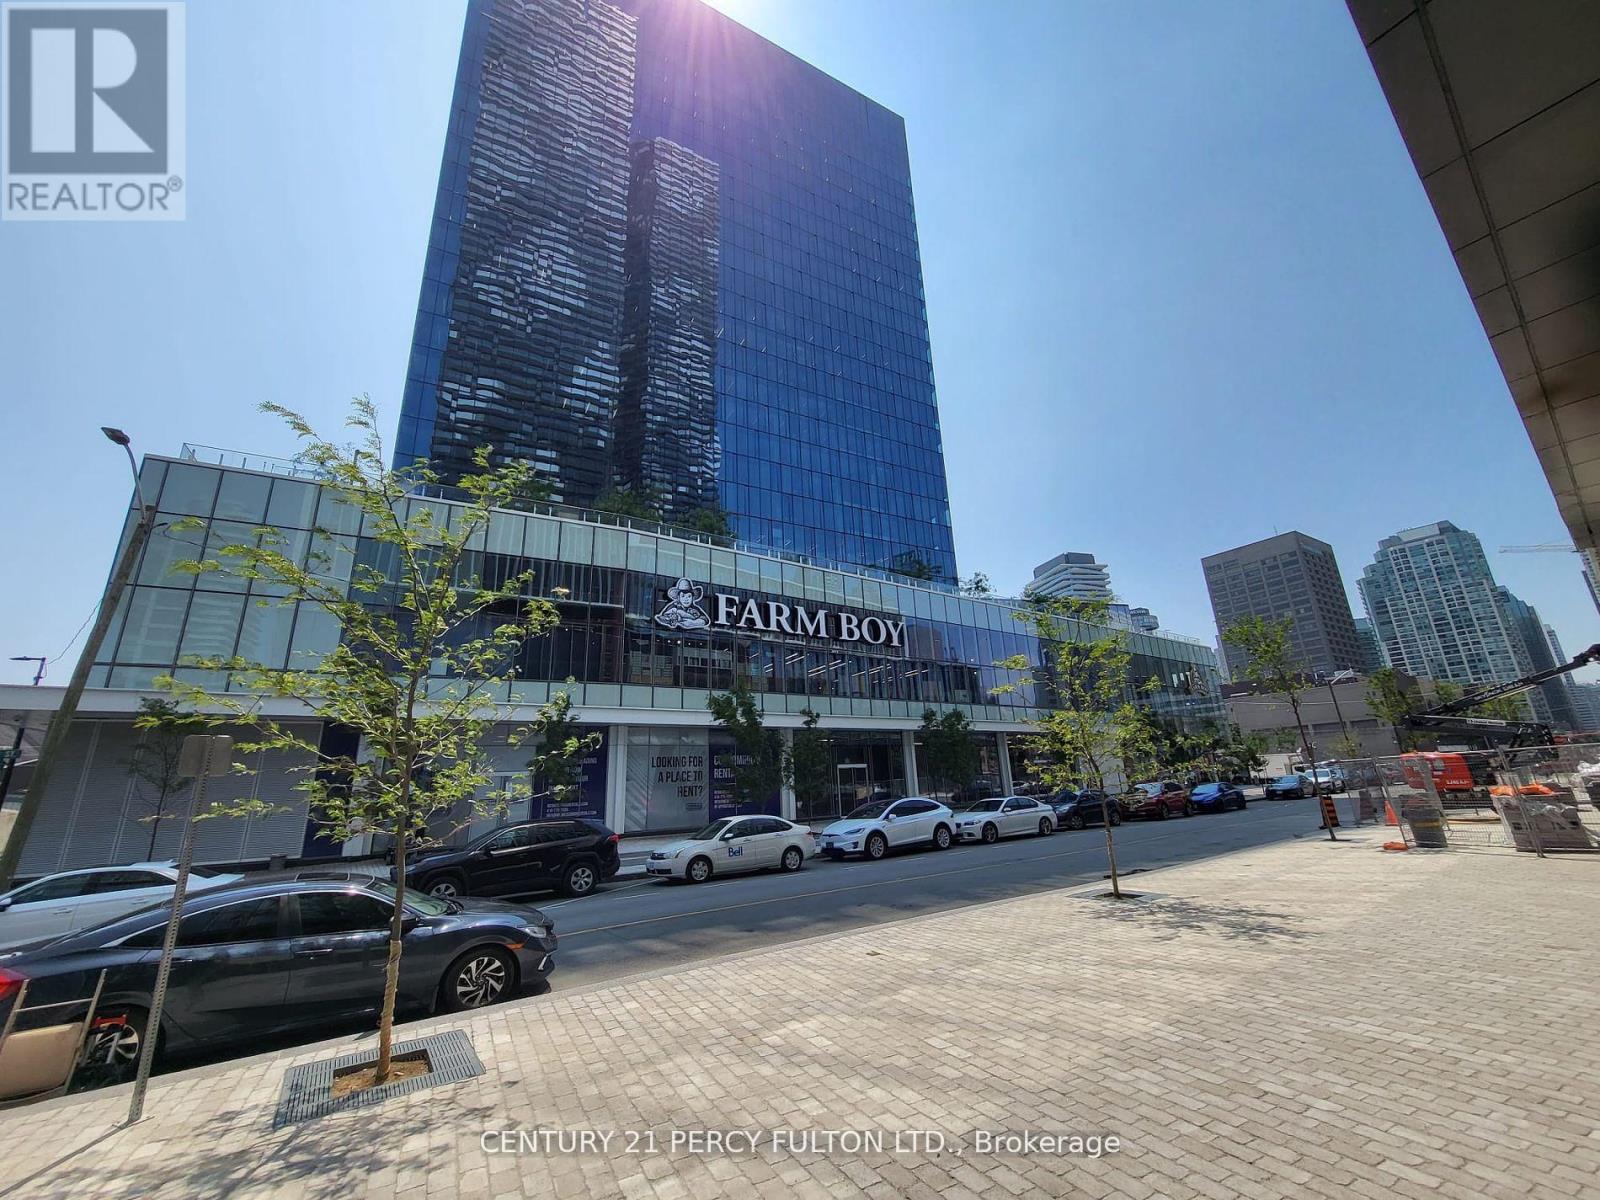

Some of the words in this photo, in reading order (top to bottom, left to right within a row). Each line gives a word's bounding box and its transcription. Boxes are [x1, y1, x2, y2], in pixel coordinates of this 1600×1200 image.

[714, 593, 829, 638] FARM
[838, 612, 905, 647] BOY
[651, 756, 687, 768] LOOKING
[688, 755, 703, 768] FOR
[657, 771, 664, 783] A
[666, 770, 692, 783] PLACE
[693, 770, 703, 782] TO
[677, 785, 703, 798] RENT?
[728, 846, 743, 858] Bell
